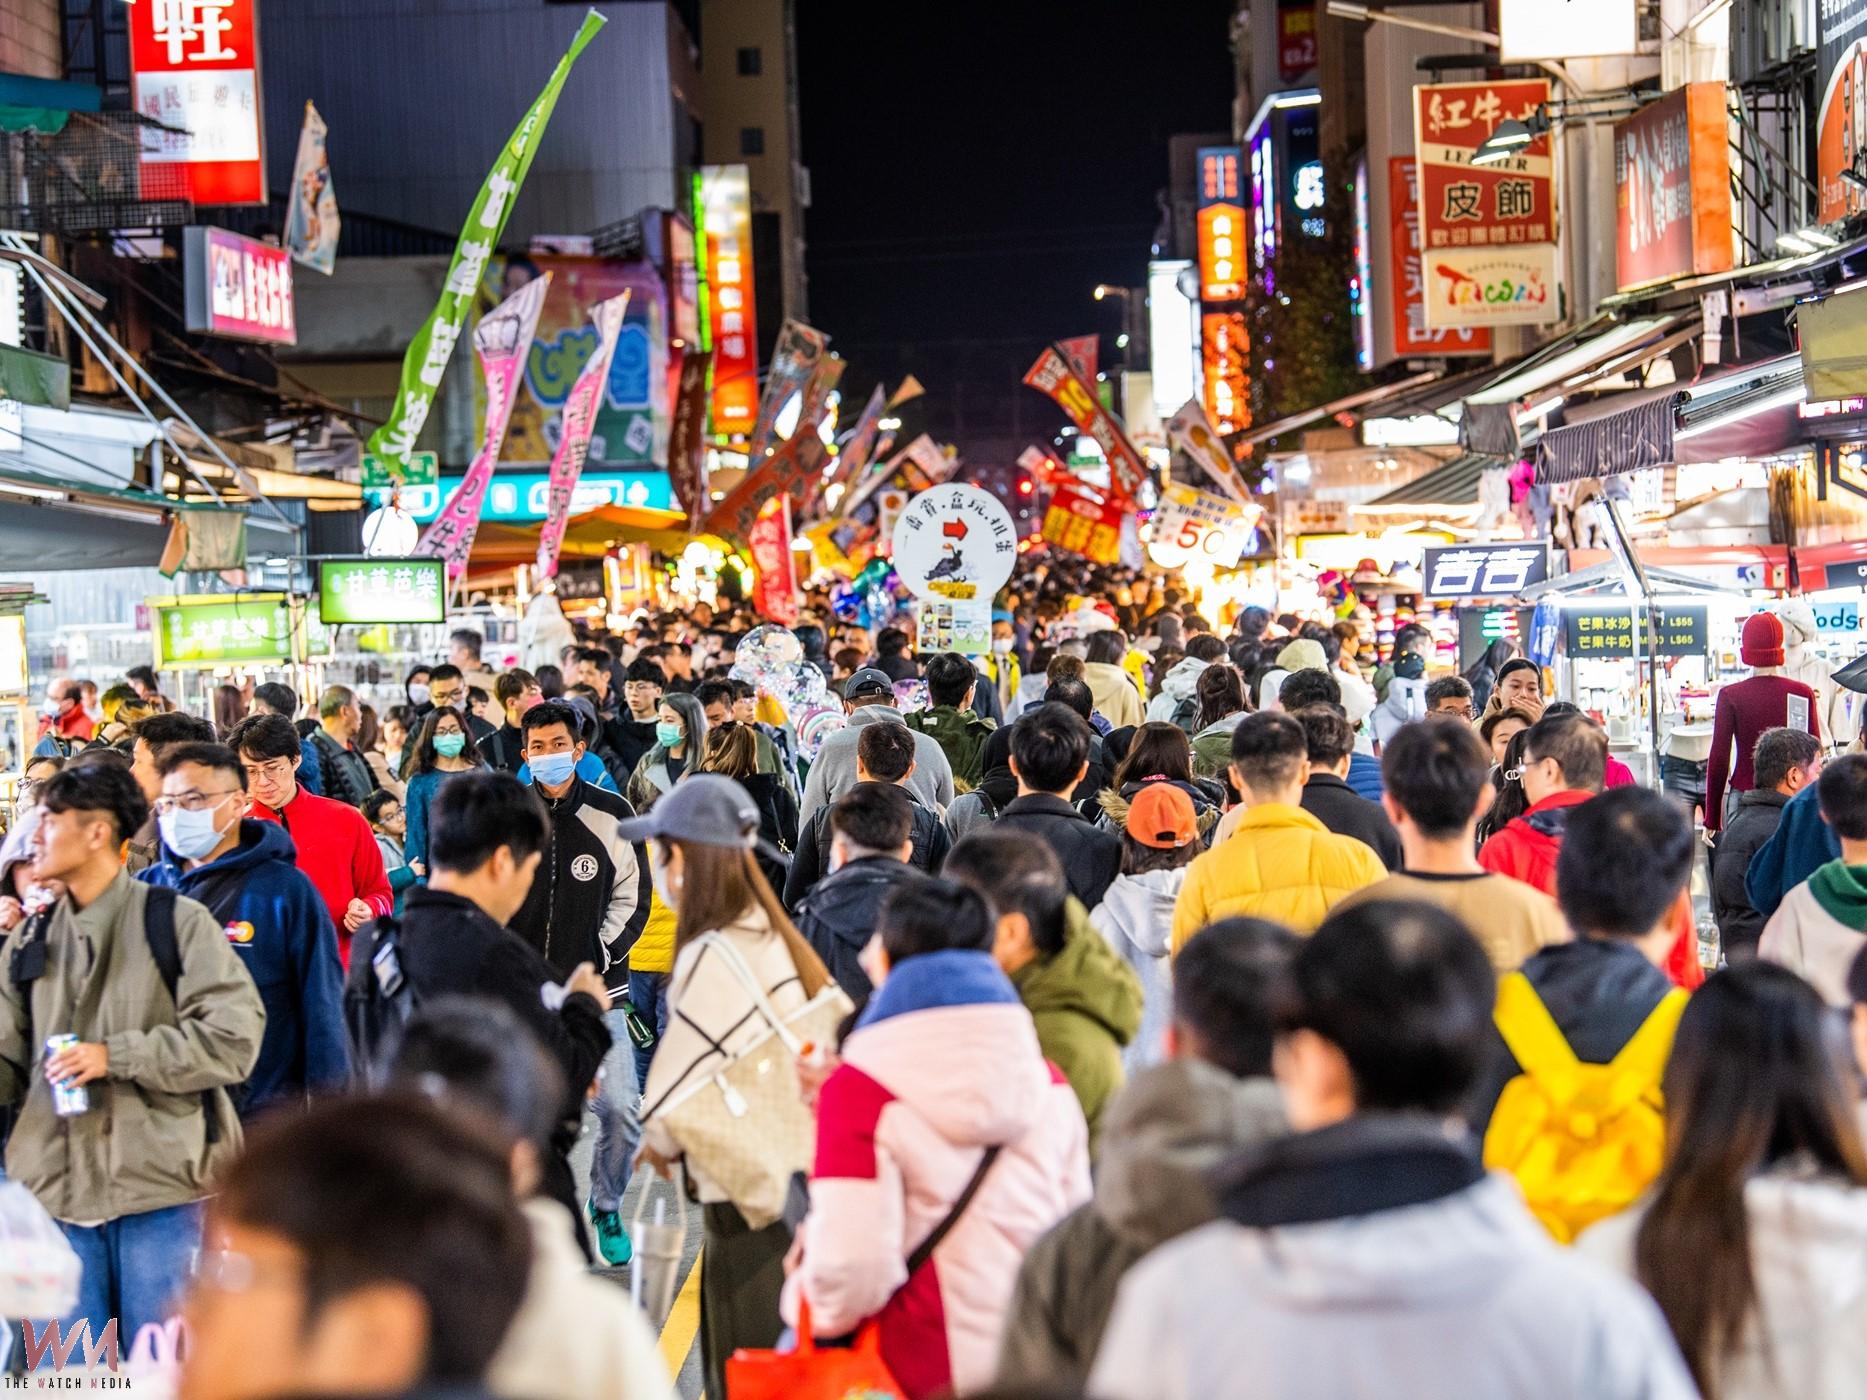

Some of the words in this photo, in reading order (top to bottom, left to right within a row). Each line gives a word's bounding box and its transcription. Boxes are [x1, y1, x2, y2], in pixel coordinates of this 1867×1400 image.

[1445, 149, 1528, 170] LEHER
[1444, 182, 1533, 219] 皮飾
[345, 566, 437, 599] 甘草芭樂
[1578, 616, 1632, 632] 芒果冰沙
[1578, 634, 1632, 649] 芒果牛奶
[581, 860, 590, 873] 6
